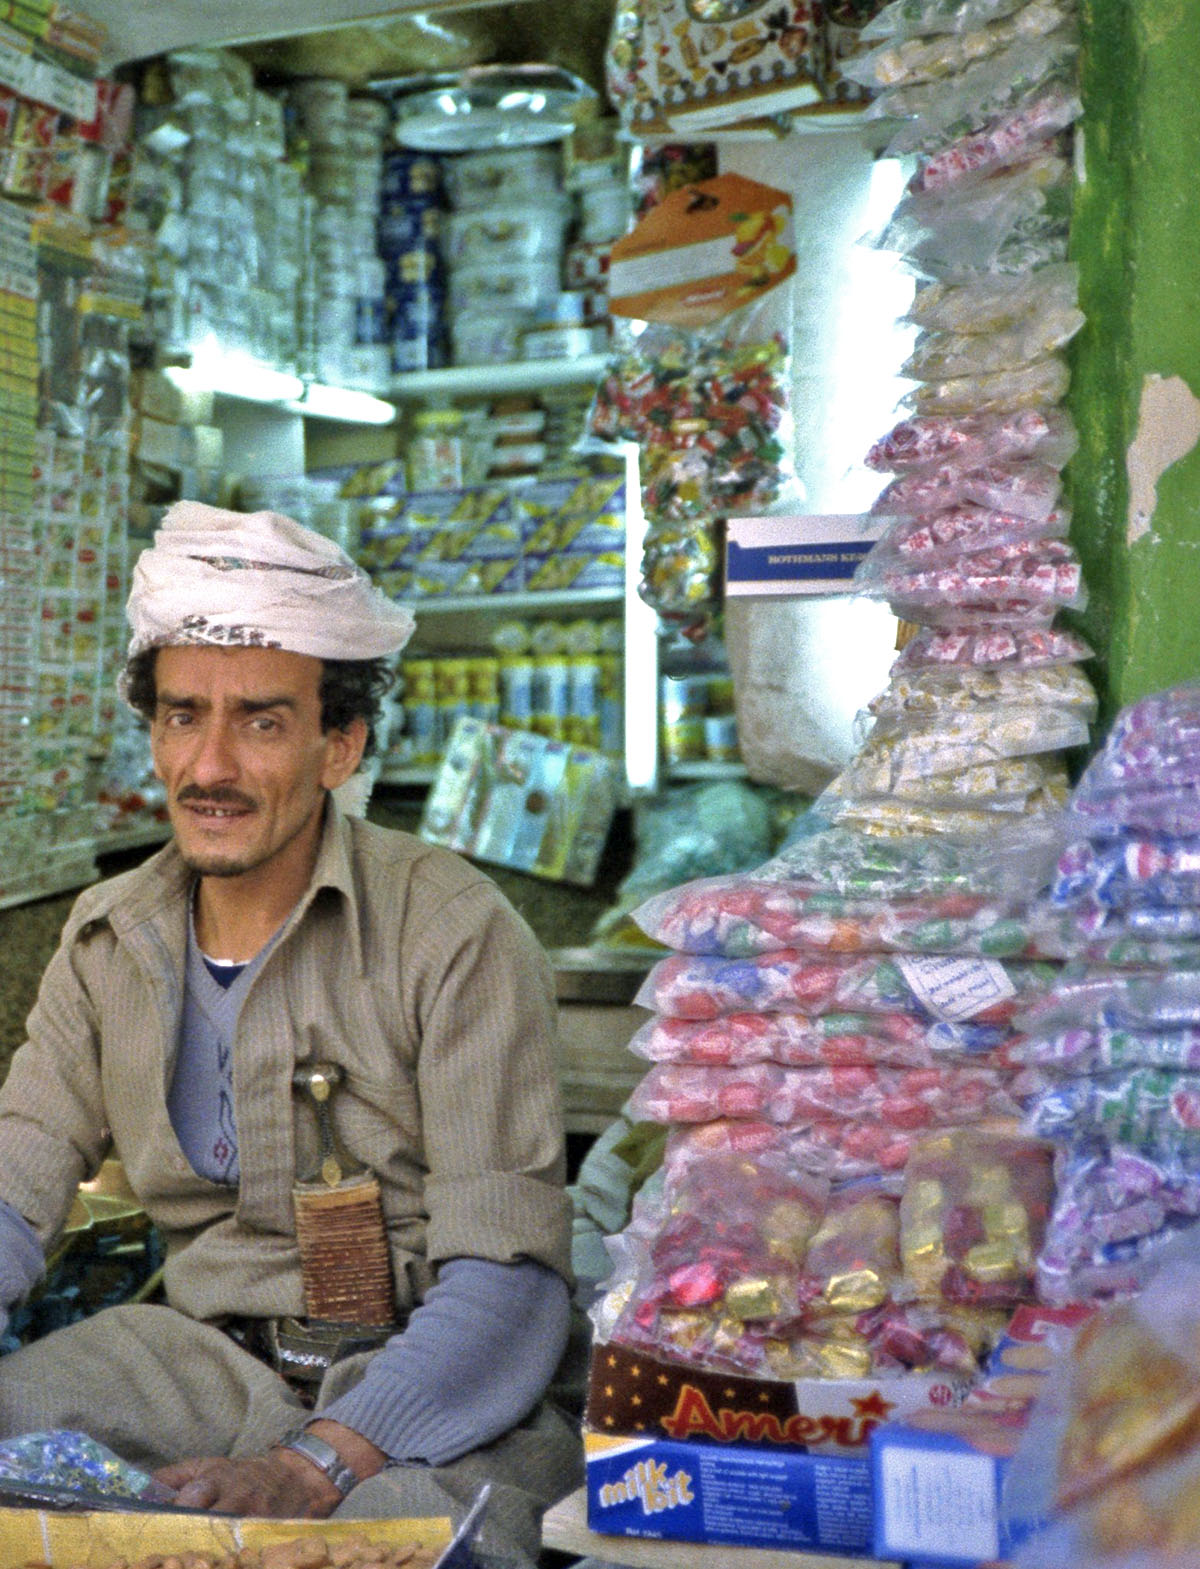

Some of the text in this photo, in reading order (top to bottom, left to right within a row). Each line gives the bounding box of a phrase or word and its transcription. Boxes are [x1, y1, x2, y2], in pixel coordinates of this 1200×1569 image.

[768, 552, 838, 565] ROTHMANS
[599, 1458, 668, 1508] milk
[642, 1470, 695, 1516] bit
